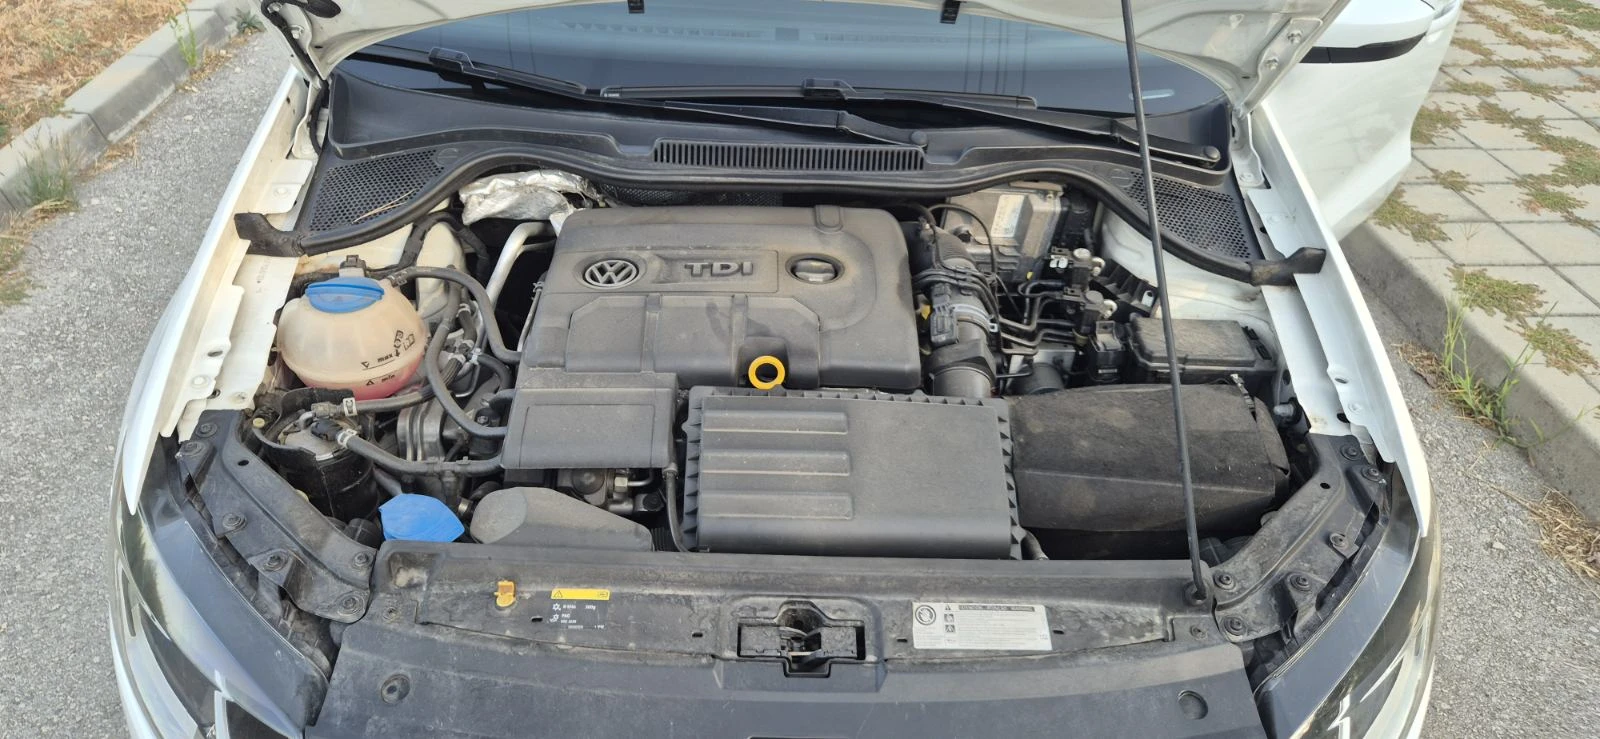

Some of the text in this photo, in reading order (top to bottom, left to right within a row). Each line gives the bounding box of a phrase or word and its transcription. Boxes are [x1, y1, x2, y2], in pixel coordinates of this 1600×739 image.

[584, 259, 639, 288] VW
[685, 261, 754, 278] TDI
[377, 353, 393, 363] max
